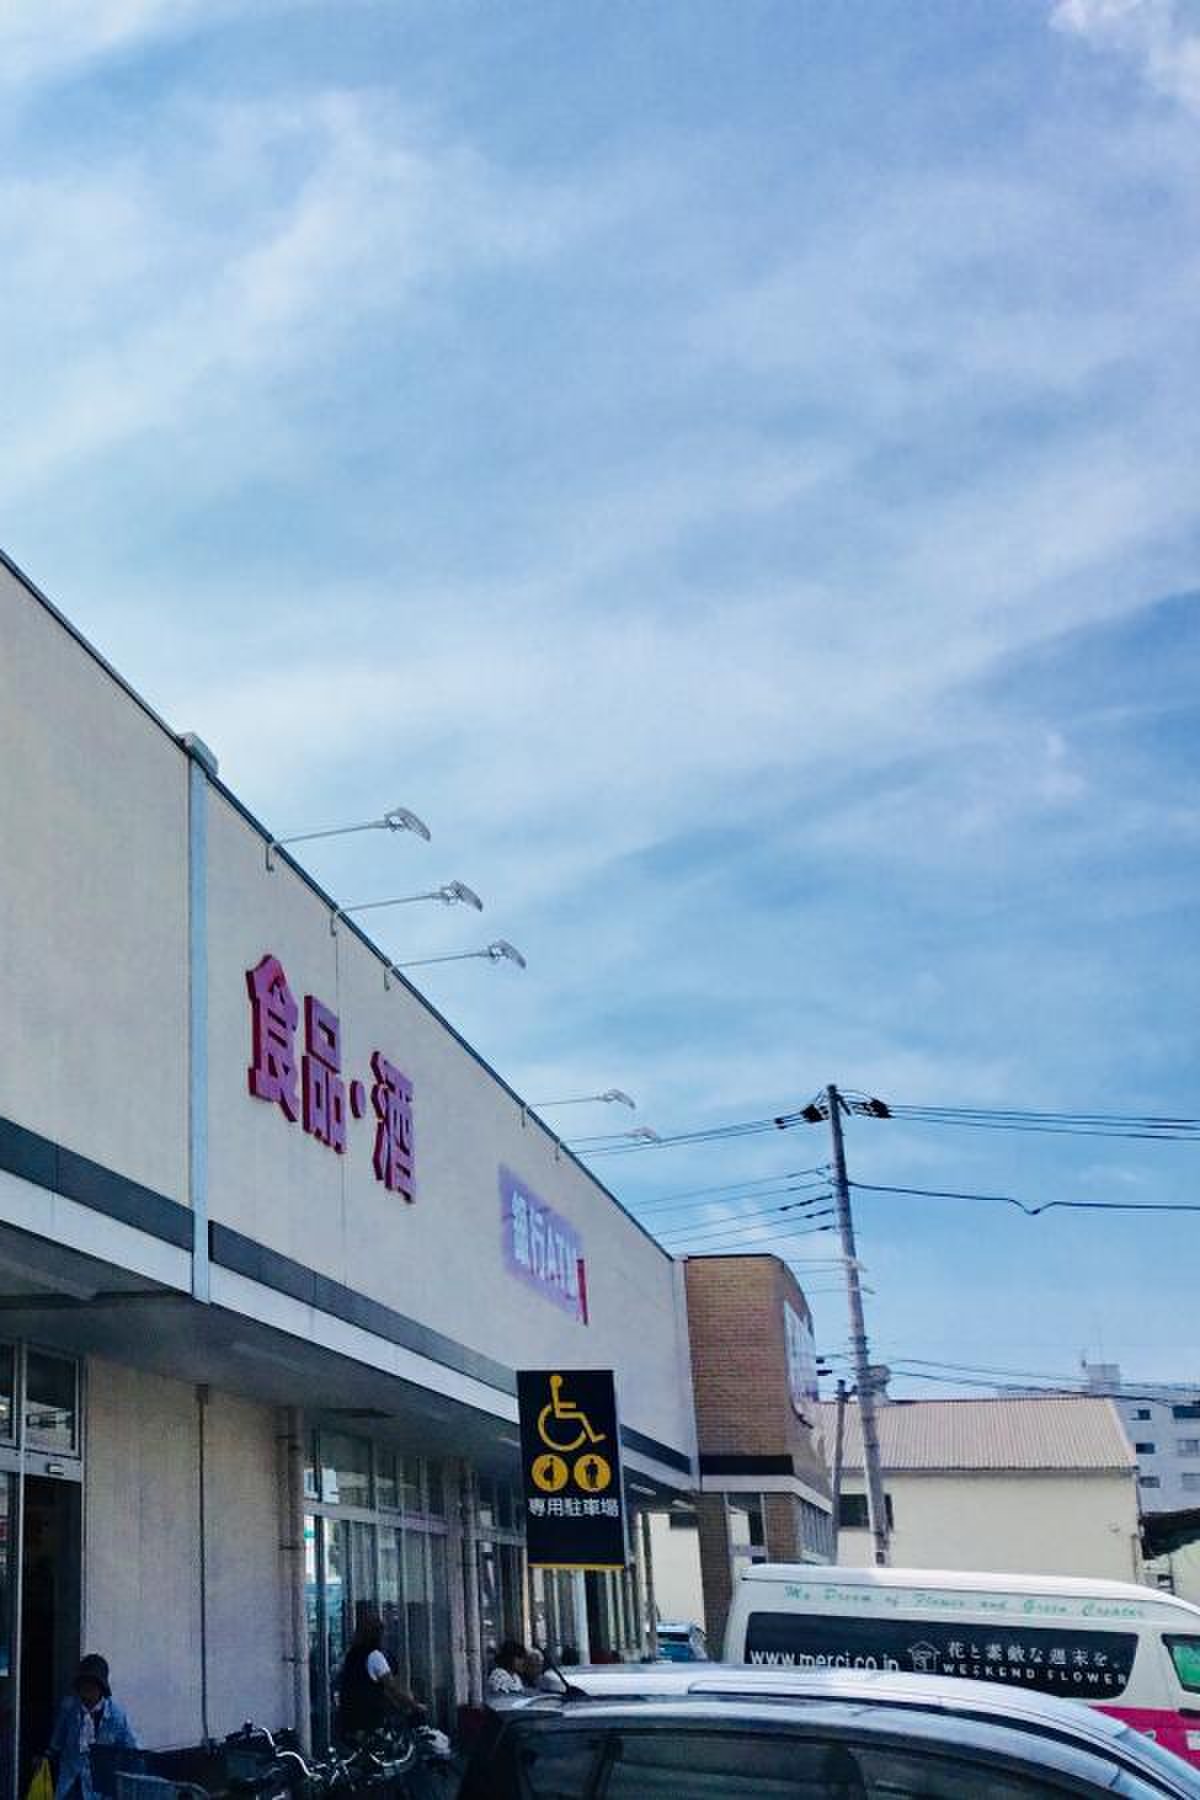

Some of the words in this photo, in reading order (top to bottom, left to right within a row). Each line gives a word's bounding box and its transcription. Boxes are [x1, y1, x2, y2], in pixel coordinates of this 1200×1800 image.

[528, 1498, 619, 1518] 専用駐車場
